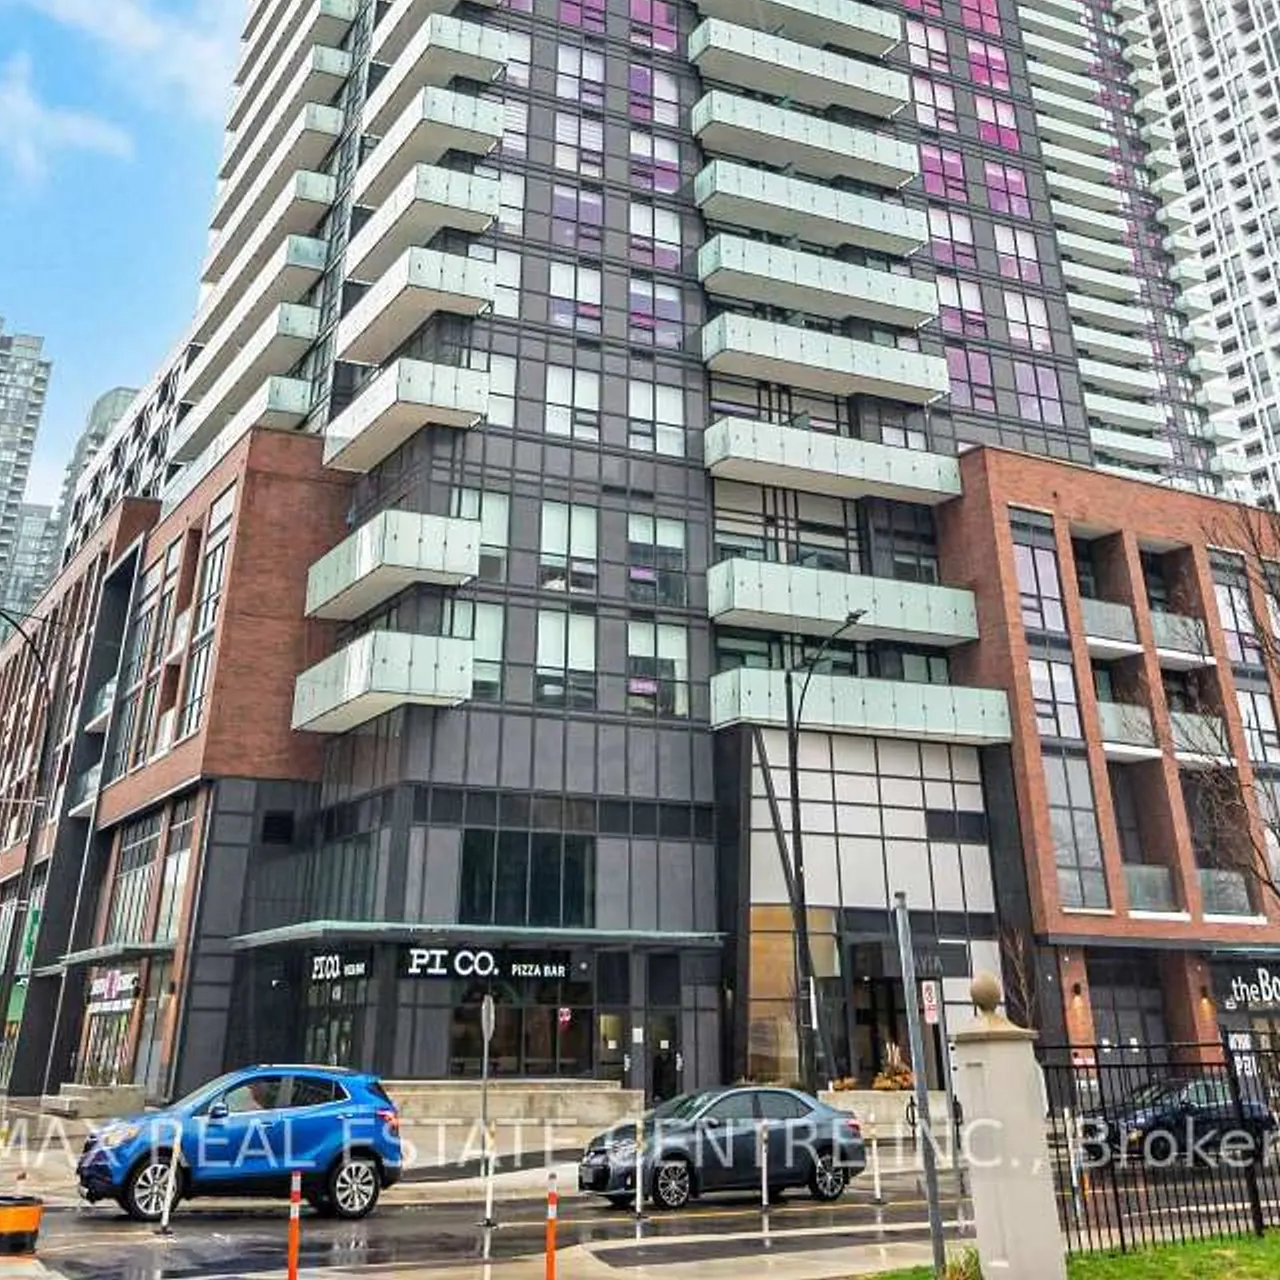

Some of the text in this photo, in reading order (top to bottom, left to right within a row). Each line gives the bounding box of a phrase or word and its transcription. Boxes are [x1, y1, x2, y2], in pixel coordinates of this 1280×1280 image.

[408, 949, 566, 978] PI CO. PIZZA BAR
[1232, 976, 1259, 1003] the
